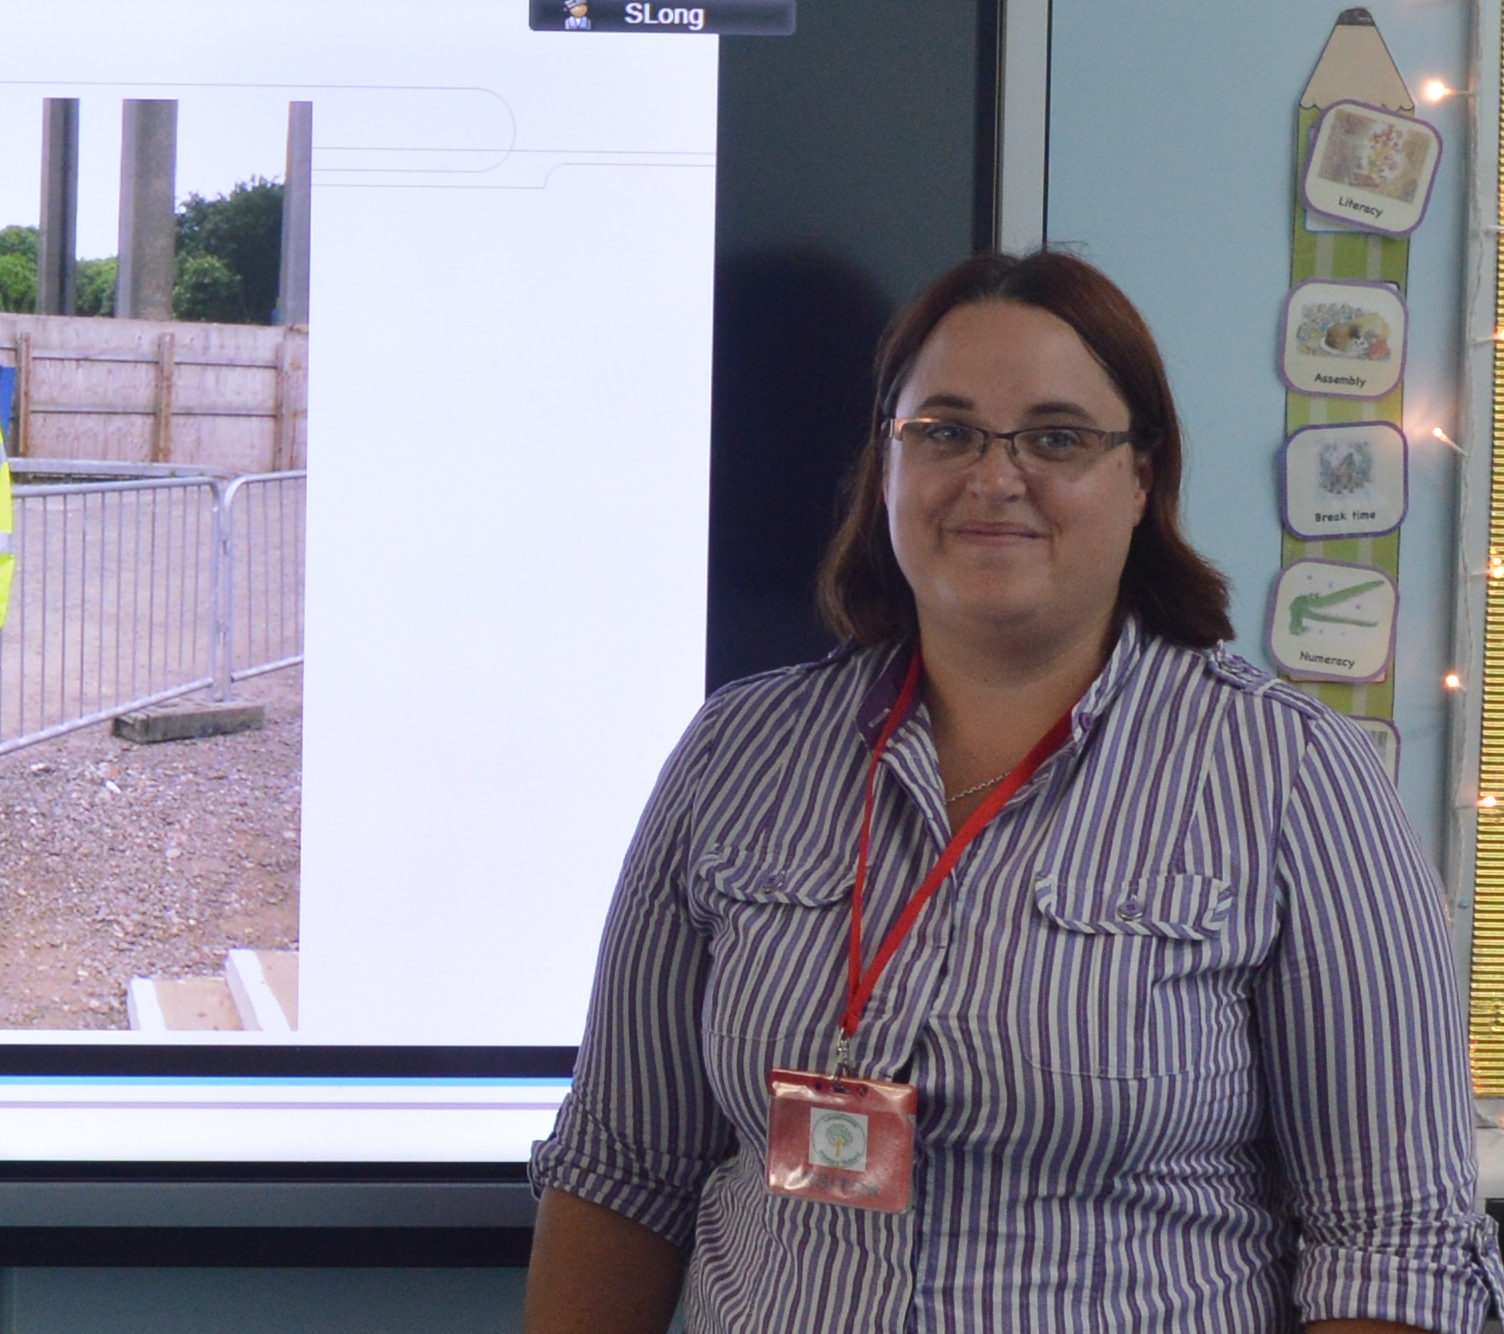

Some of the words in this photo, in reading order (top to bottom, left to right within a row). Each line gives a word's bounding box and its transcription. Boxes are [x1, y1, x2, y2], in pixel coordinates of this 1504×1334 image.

[625, 2, 704, 30] SLong
[1338, 196, 1384, 218] Literacy
[1314, 372, 1367, 389] Assembly
[1314, 510, 1347, 524] Break
[1351, 509, 1376, 521] time
[1299, 650, 1356, 670] Numeracy
